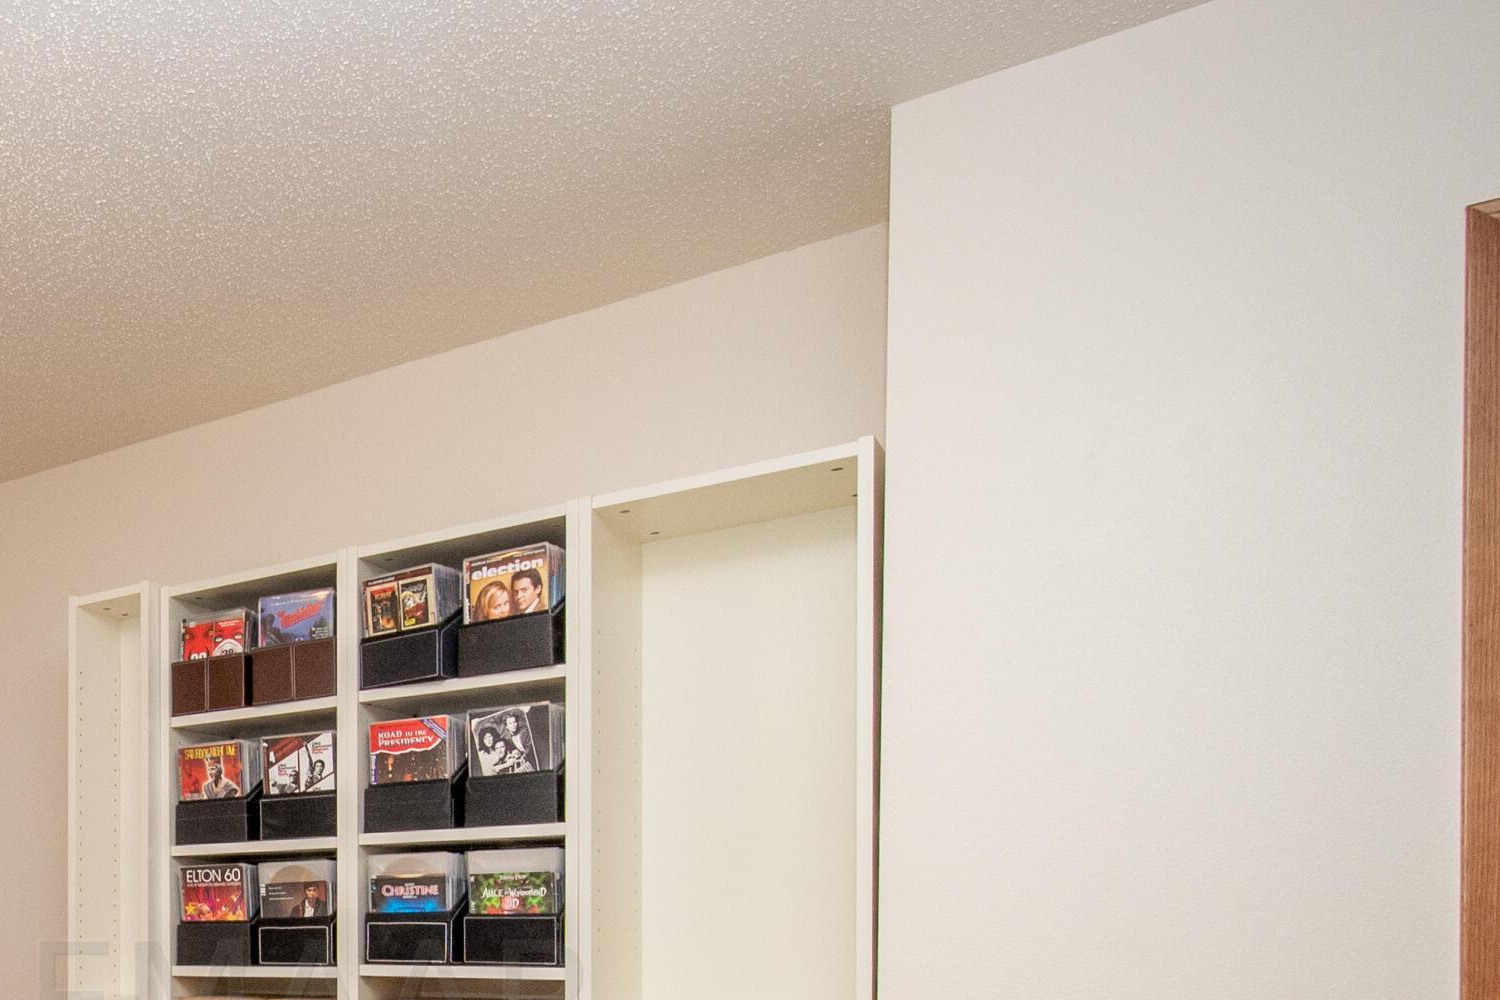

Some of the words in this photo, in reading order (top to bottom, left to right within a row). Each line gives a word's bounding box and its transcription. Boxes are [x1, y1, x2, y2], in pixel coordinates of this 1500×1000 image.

[471, 557, 544, 581] election
[377, 730, 403, 740] ROAD
[377, 735, 434, 748] PRESIDENCY
[186, 868, 222, 883] ELTON
[224, 868, 241, 882] 60
[381, 884, 440, 897] CHRISTINE
